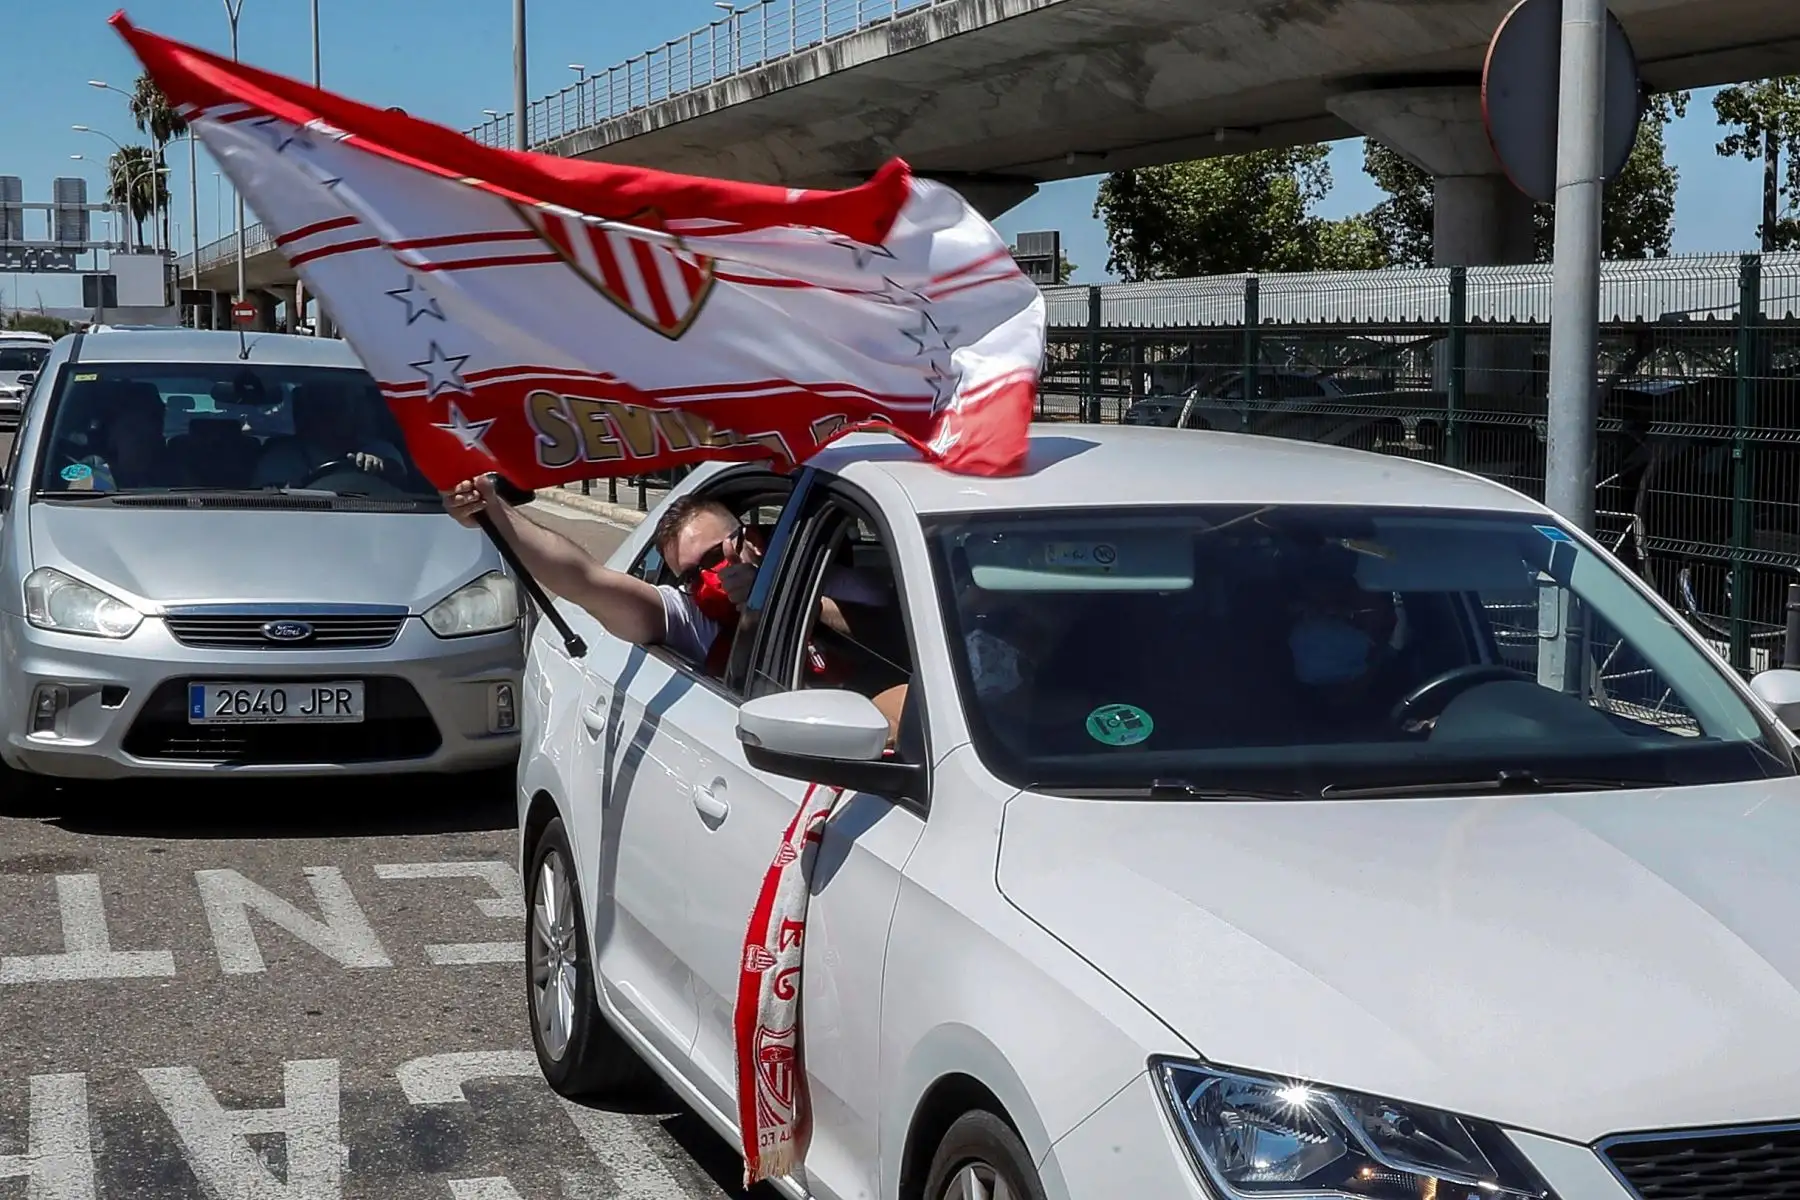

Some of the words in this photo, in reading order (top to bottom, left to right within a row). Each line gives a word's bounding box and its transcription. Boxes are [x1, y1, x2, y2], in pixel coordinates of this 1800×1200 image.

[194, 705, 201, 713] E
[214, 688, 287, 716] 2640
[300, 688, 352, 715] JPR
